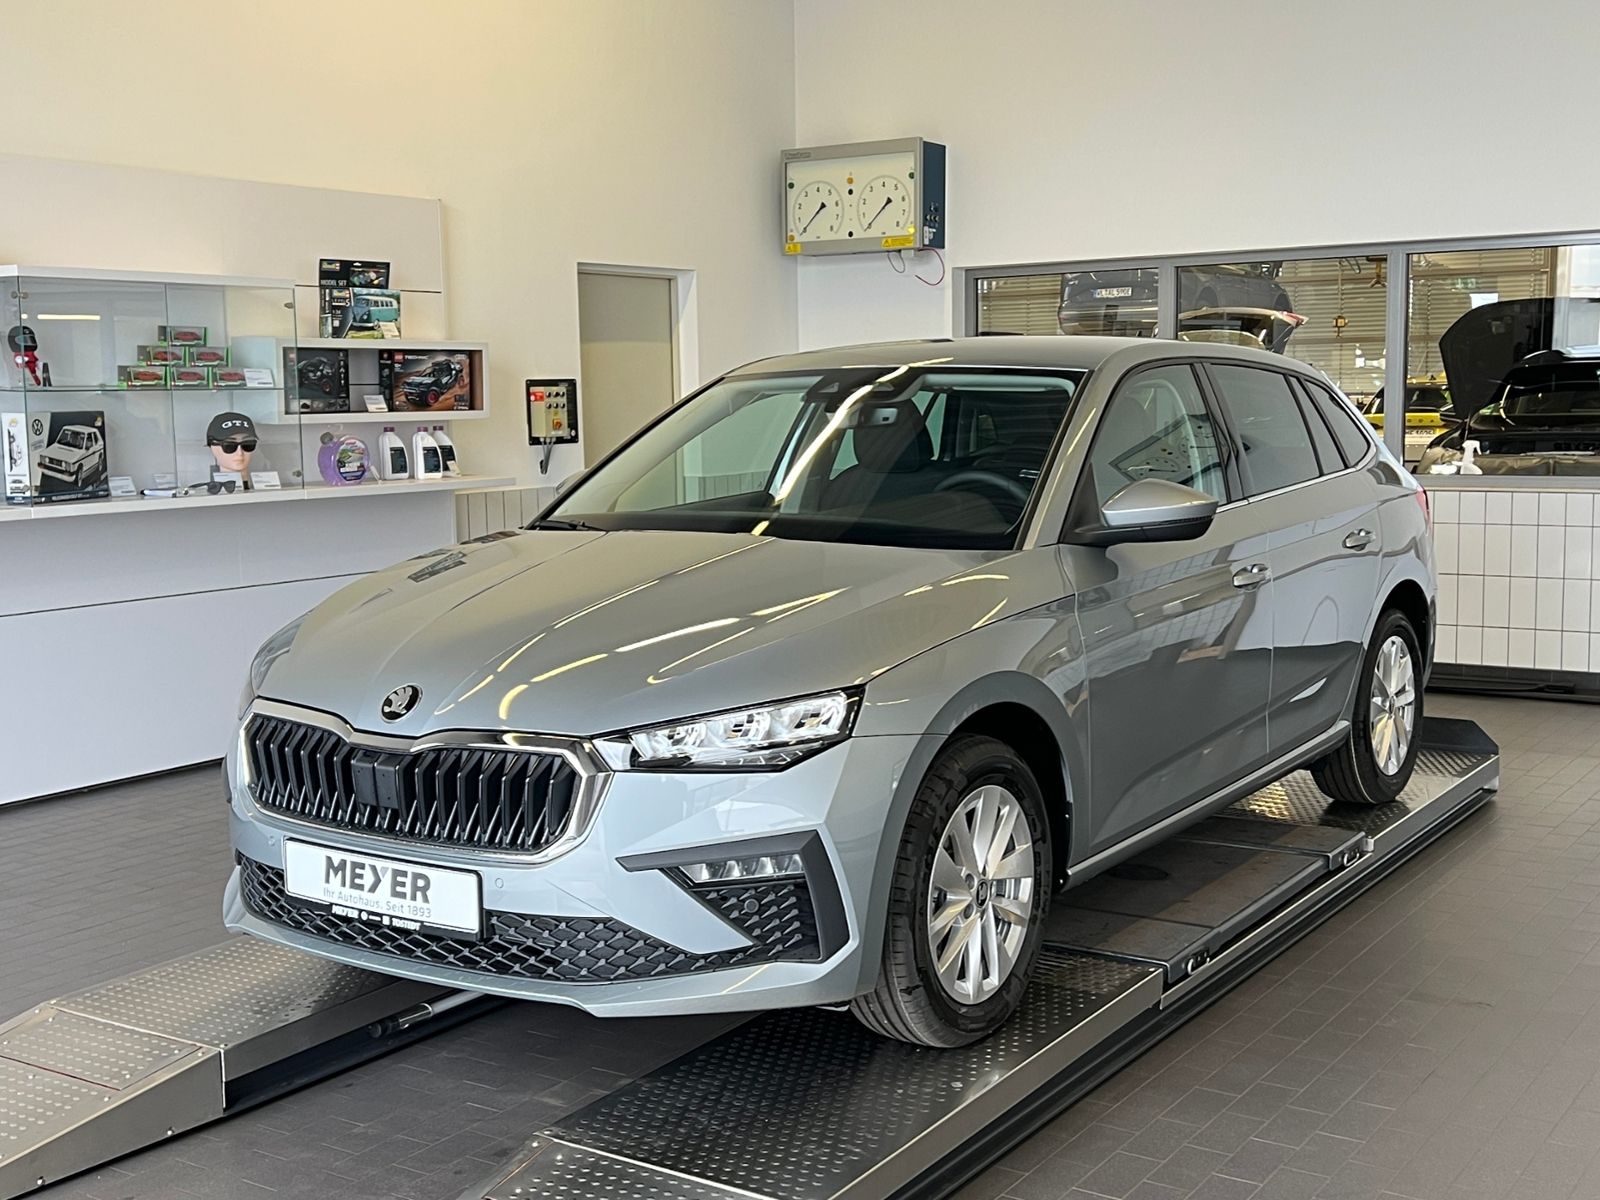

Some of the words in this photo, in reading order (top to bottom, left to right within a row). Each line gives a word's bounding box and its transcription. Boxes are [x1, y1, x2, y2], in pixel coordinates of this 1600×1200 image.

[222, 420, 249, 429] GTI
[324, 855, 431, 904] MEYER
[323, 888, 335, 899] Ihr
[338, 891, 383, 909] Autohaus.
[386, 900, 405, 914] Seit
[407, 905, 432, 919] 1893
